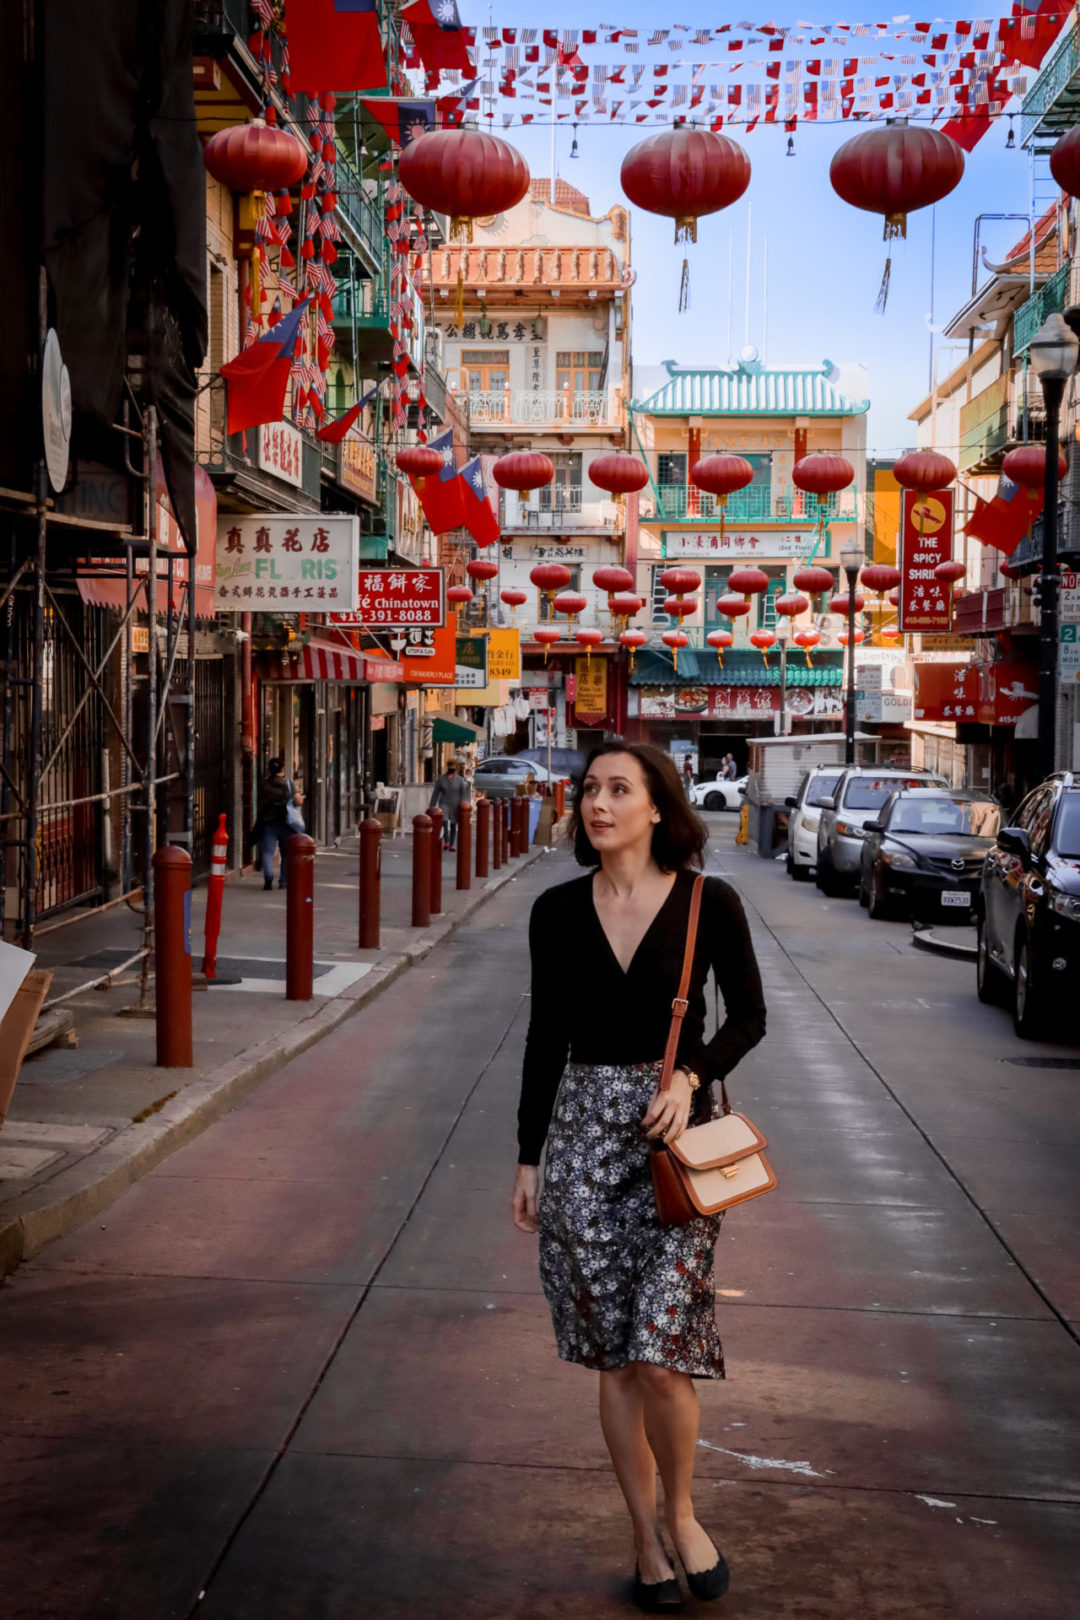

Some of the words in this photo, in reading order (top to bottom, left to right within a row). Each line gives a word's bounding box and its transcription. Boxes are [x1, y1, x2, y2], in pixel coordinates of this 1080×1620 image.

[225, 526, 330, 554] 真真花店
[919, 537, 938, 548] THE
[913, 553, 942, 563] SPICY
[301, 558, 338, 580] RIS
[909, 569, 937, 580] SHRI
[364, 573, 432, 593] 福餅家
[1062, 574, 1075, 587] NO
[374, 598, 439, 609] Chinatown
[340, 610, 432, 621] 415-391-8088
[1064, 629, 1074, 641] 2
[407, 647, 423, 655] UTOPIA
[1062, 656, 1078, 664] MON
[438, 671, 453, 679] PLACE
[489, 668, 511, 676] 8349
